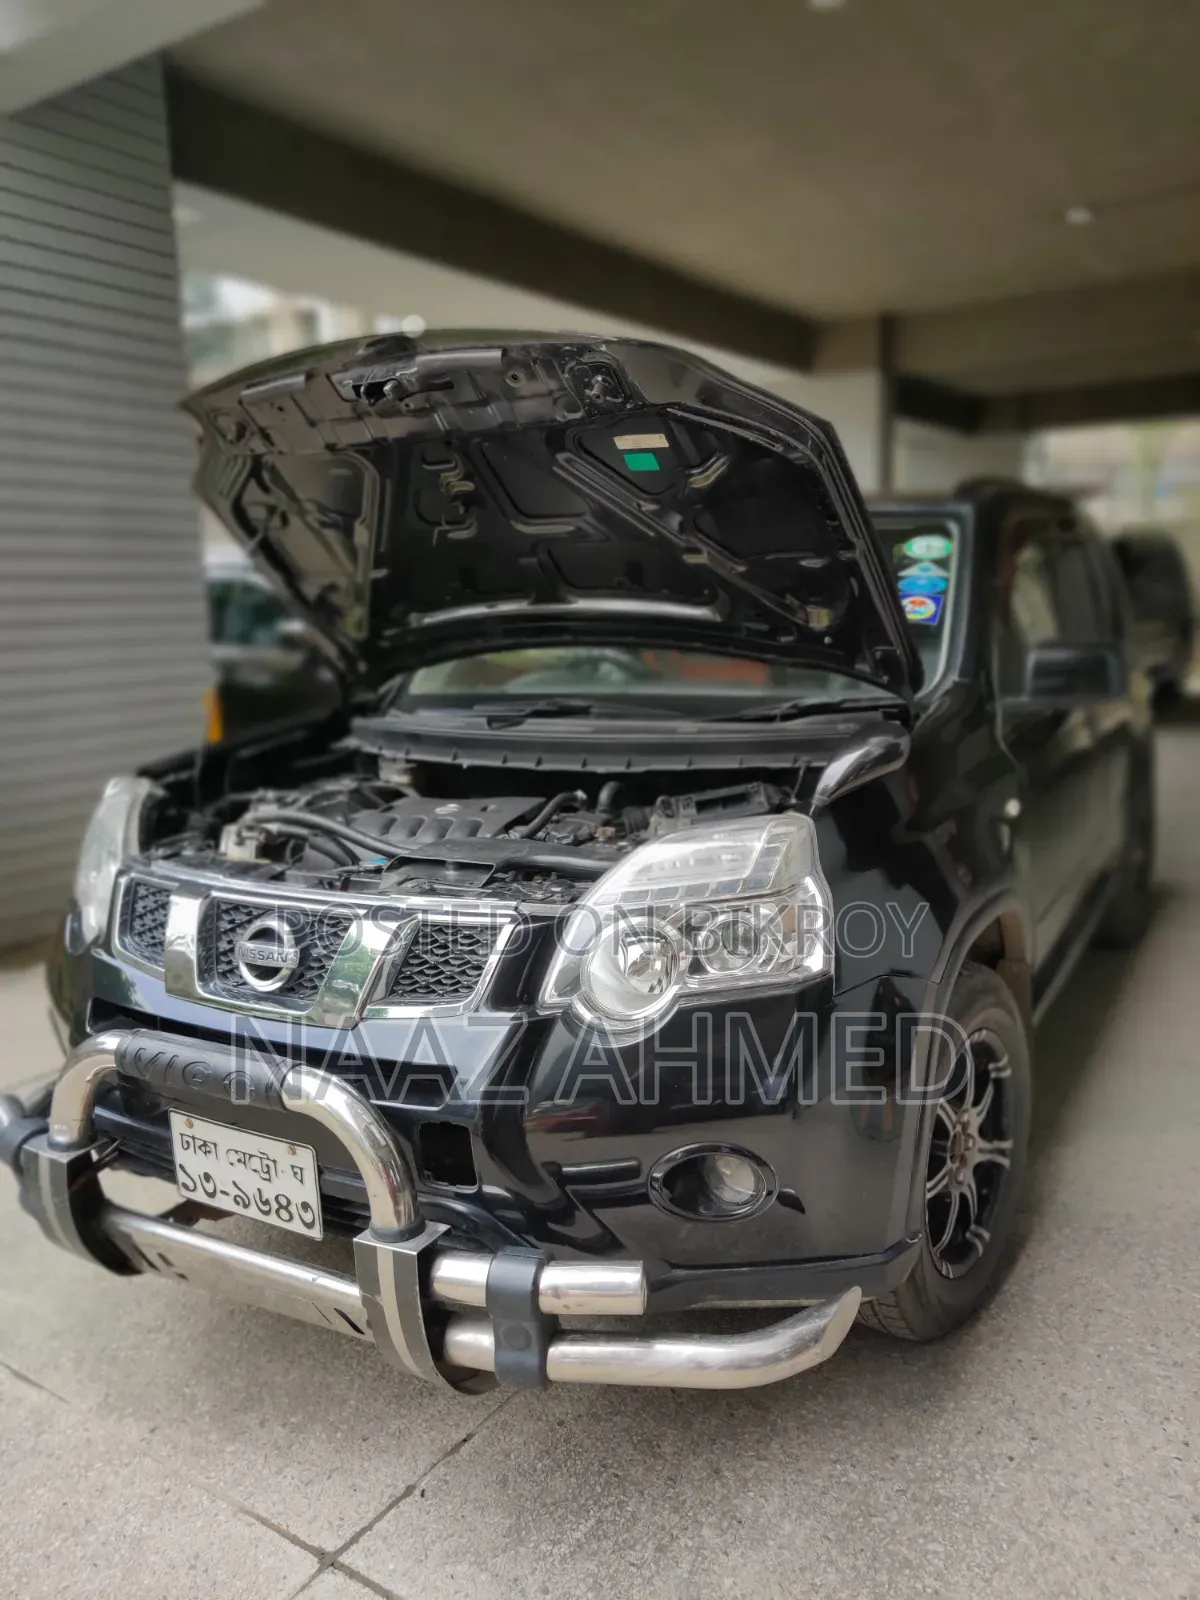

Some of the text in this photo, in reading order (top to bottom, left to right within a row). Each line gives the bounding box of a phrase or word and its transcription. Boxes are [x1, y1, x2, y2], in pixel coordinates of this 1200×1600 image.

[240, 947, 289, 963] NISSAN
[179, 1132, 218, 1161] ঢাকা
[178, 1163, 316, 1230] ১৩-৯৬৪৩
